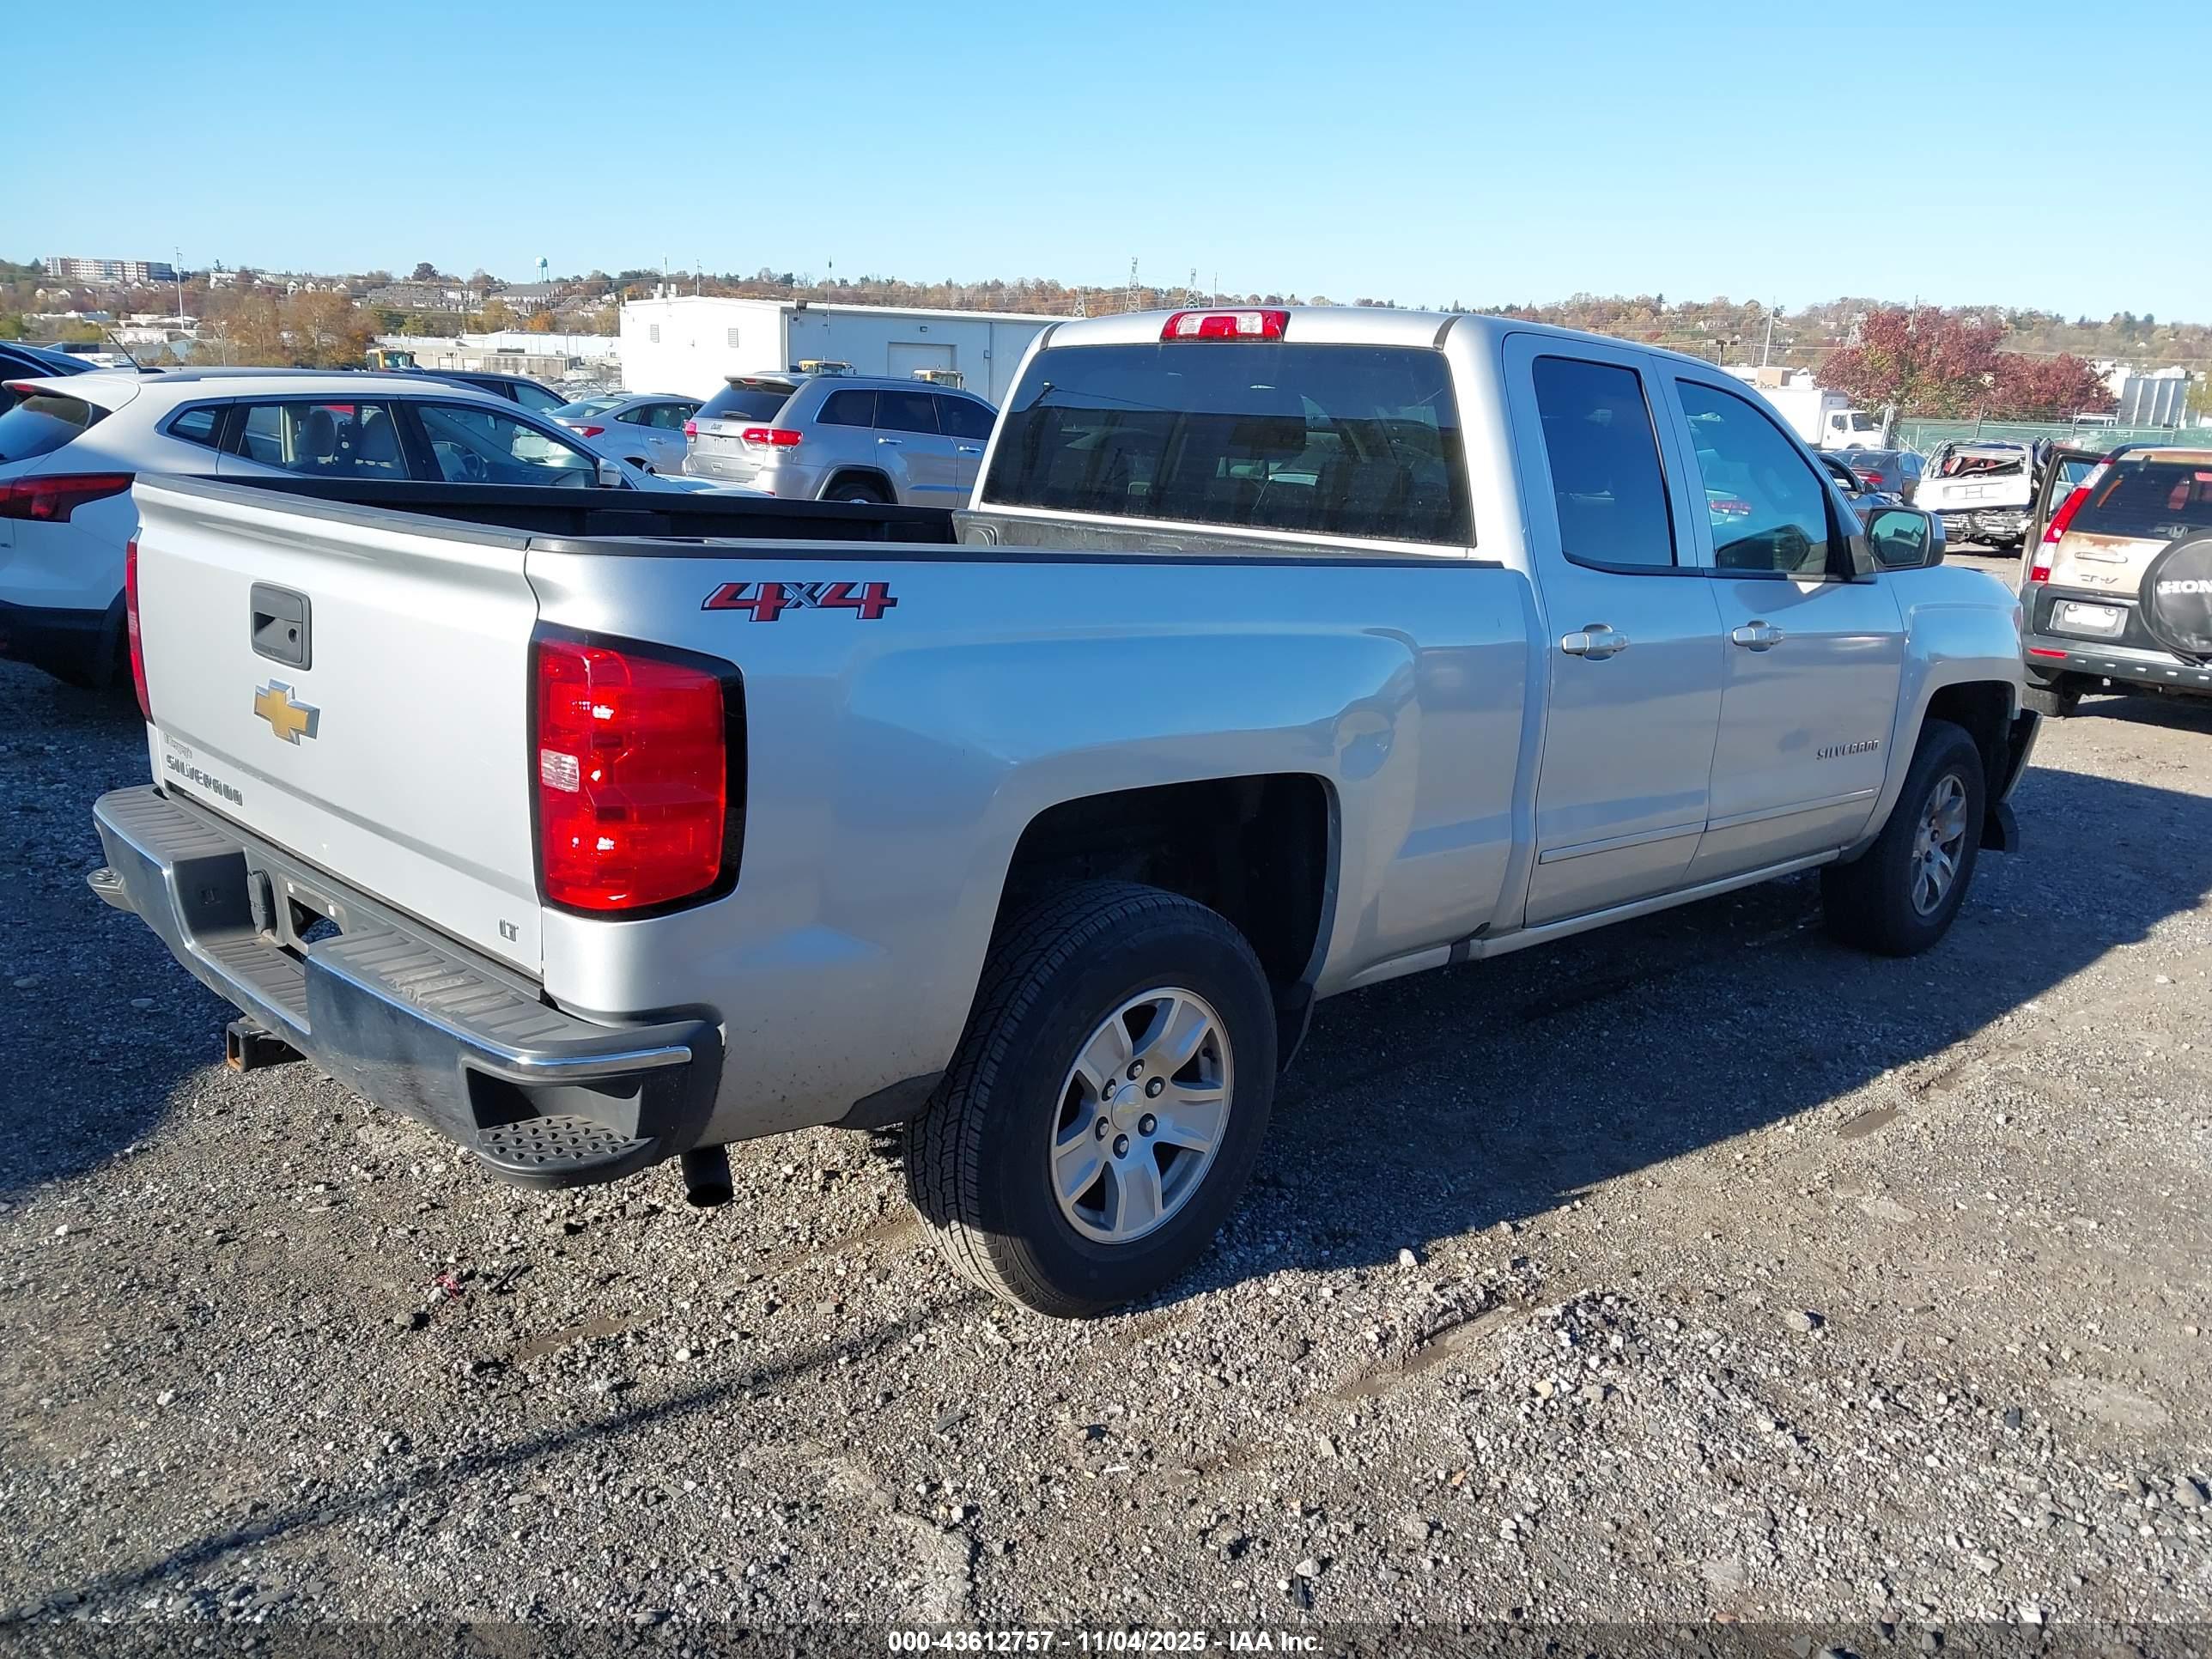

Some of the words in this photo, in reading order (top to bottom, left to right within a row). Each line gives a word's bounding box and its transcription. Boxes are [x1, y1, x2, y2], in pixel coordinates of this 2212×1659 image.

[1816, 739, 1879, 760] SILVERADO
[166, 754, 244, 806] SILVERADO
[499, 918, 520, 942] LT
